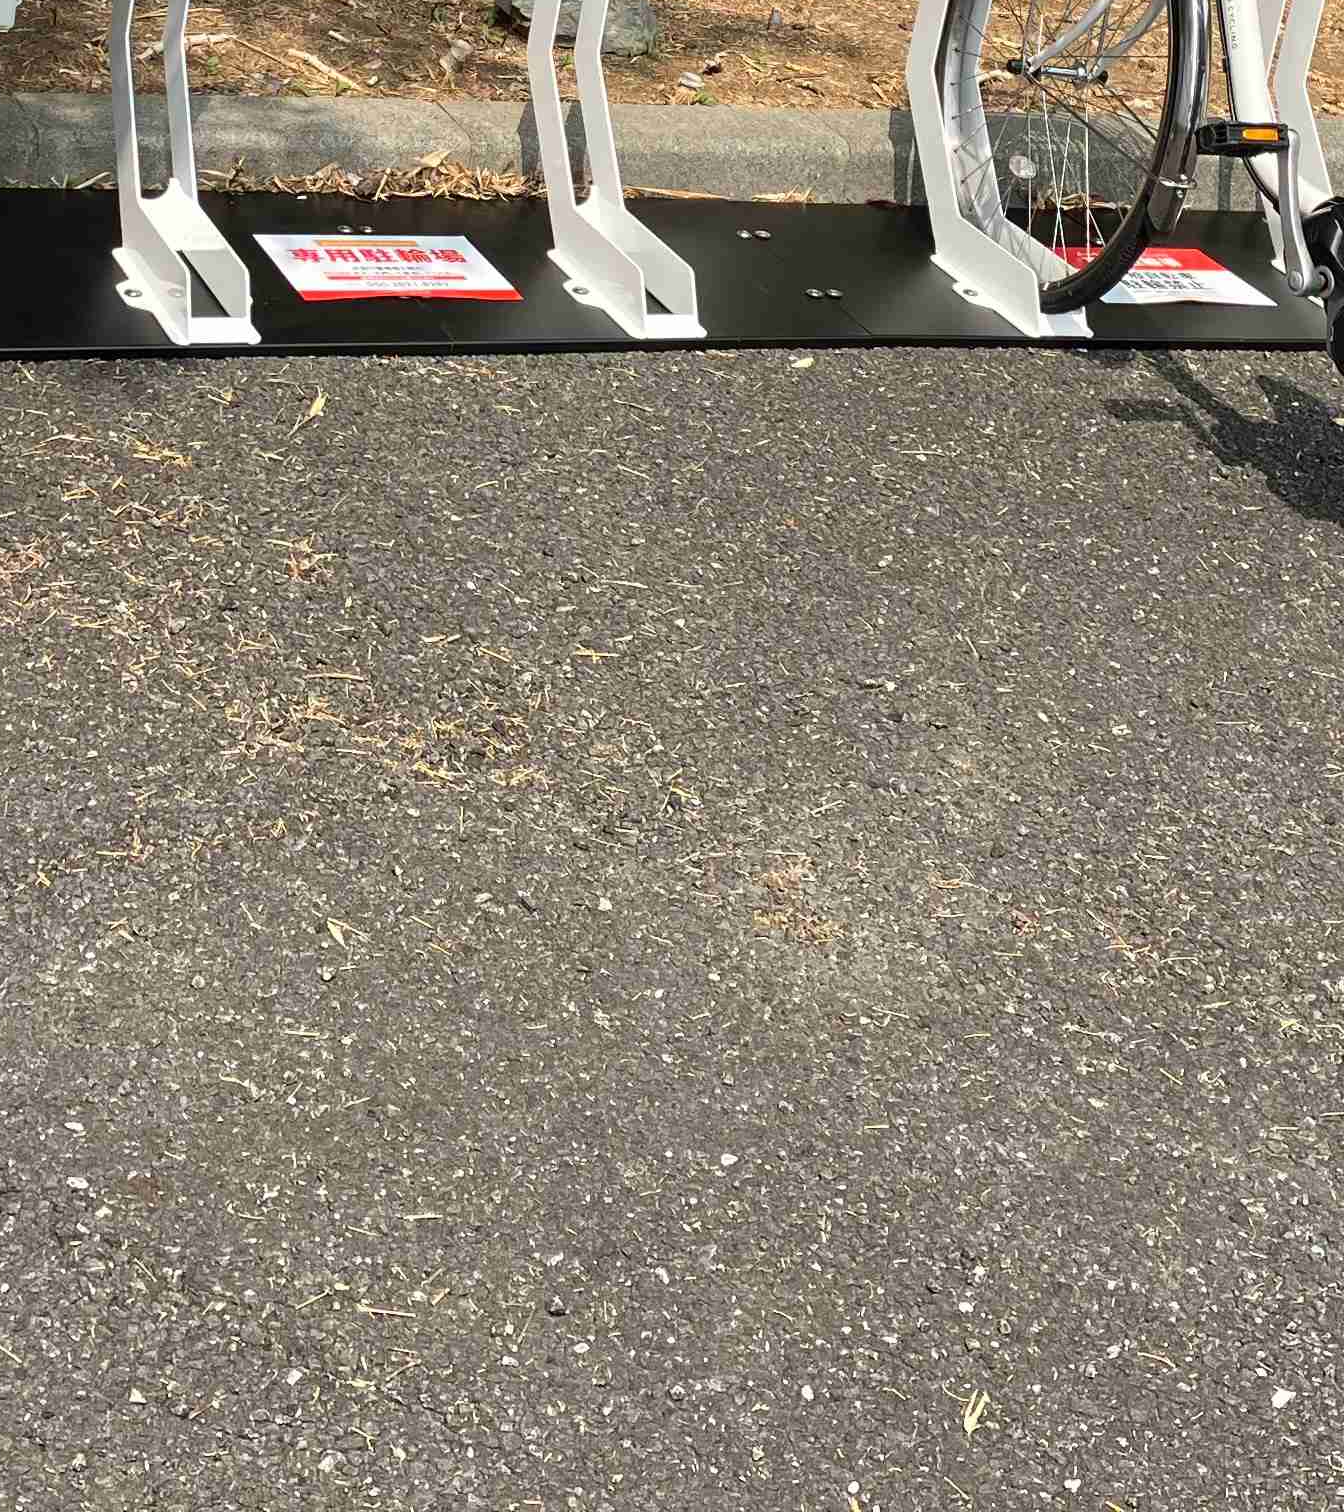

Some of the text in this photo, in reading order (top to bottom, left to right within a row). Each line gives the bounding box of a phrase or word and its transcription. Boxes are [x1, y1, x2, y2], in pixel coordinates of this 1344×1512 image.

[289, 248, 468, 263] 専用駐輪場
